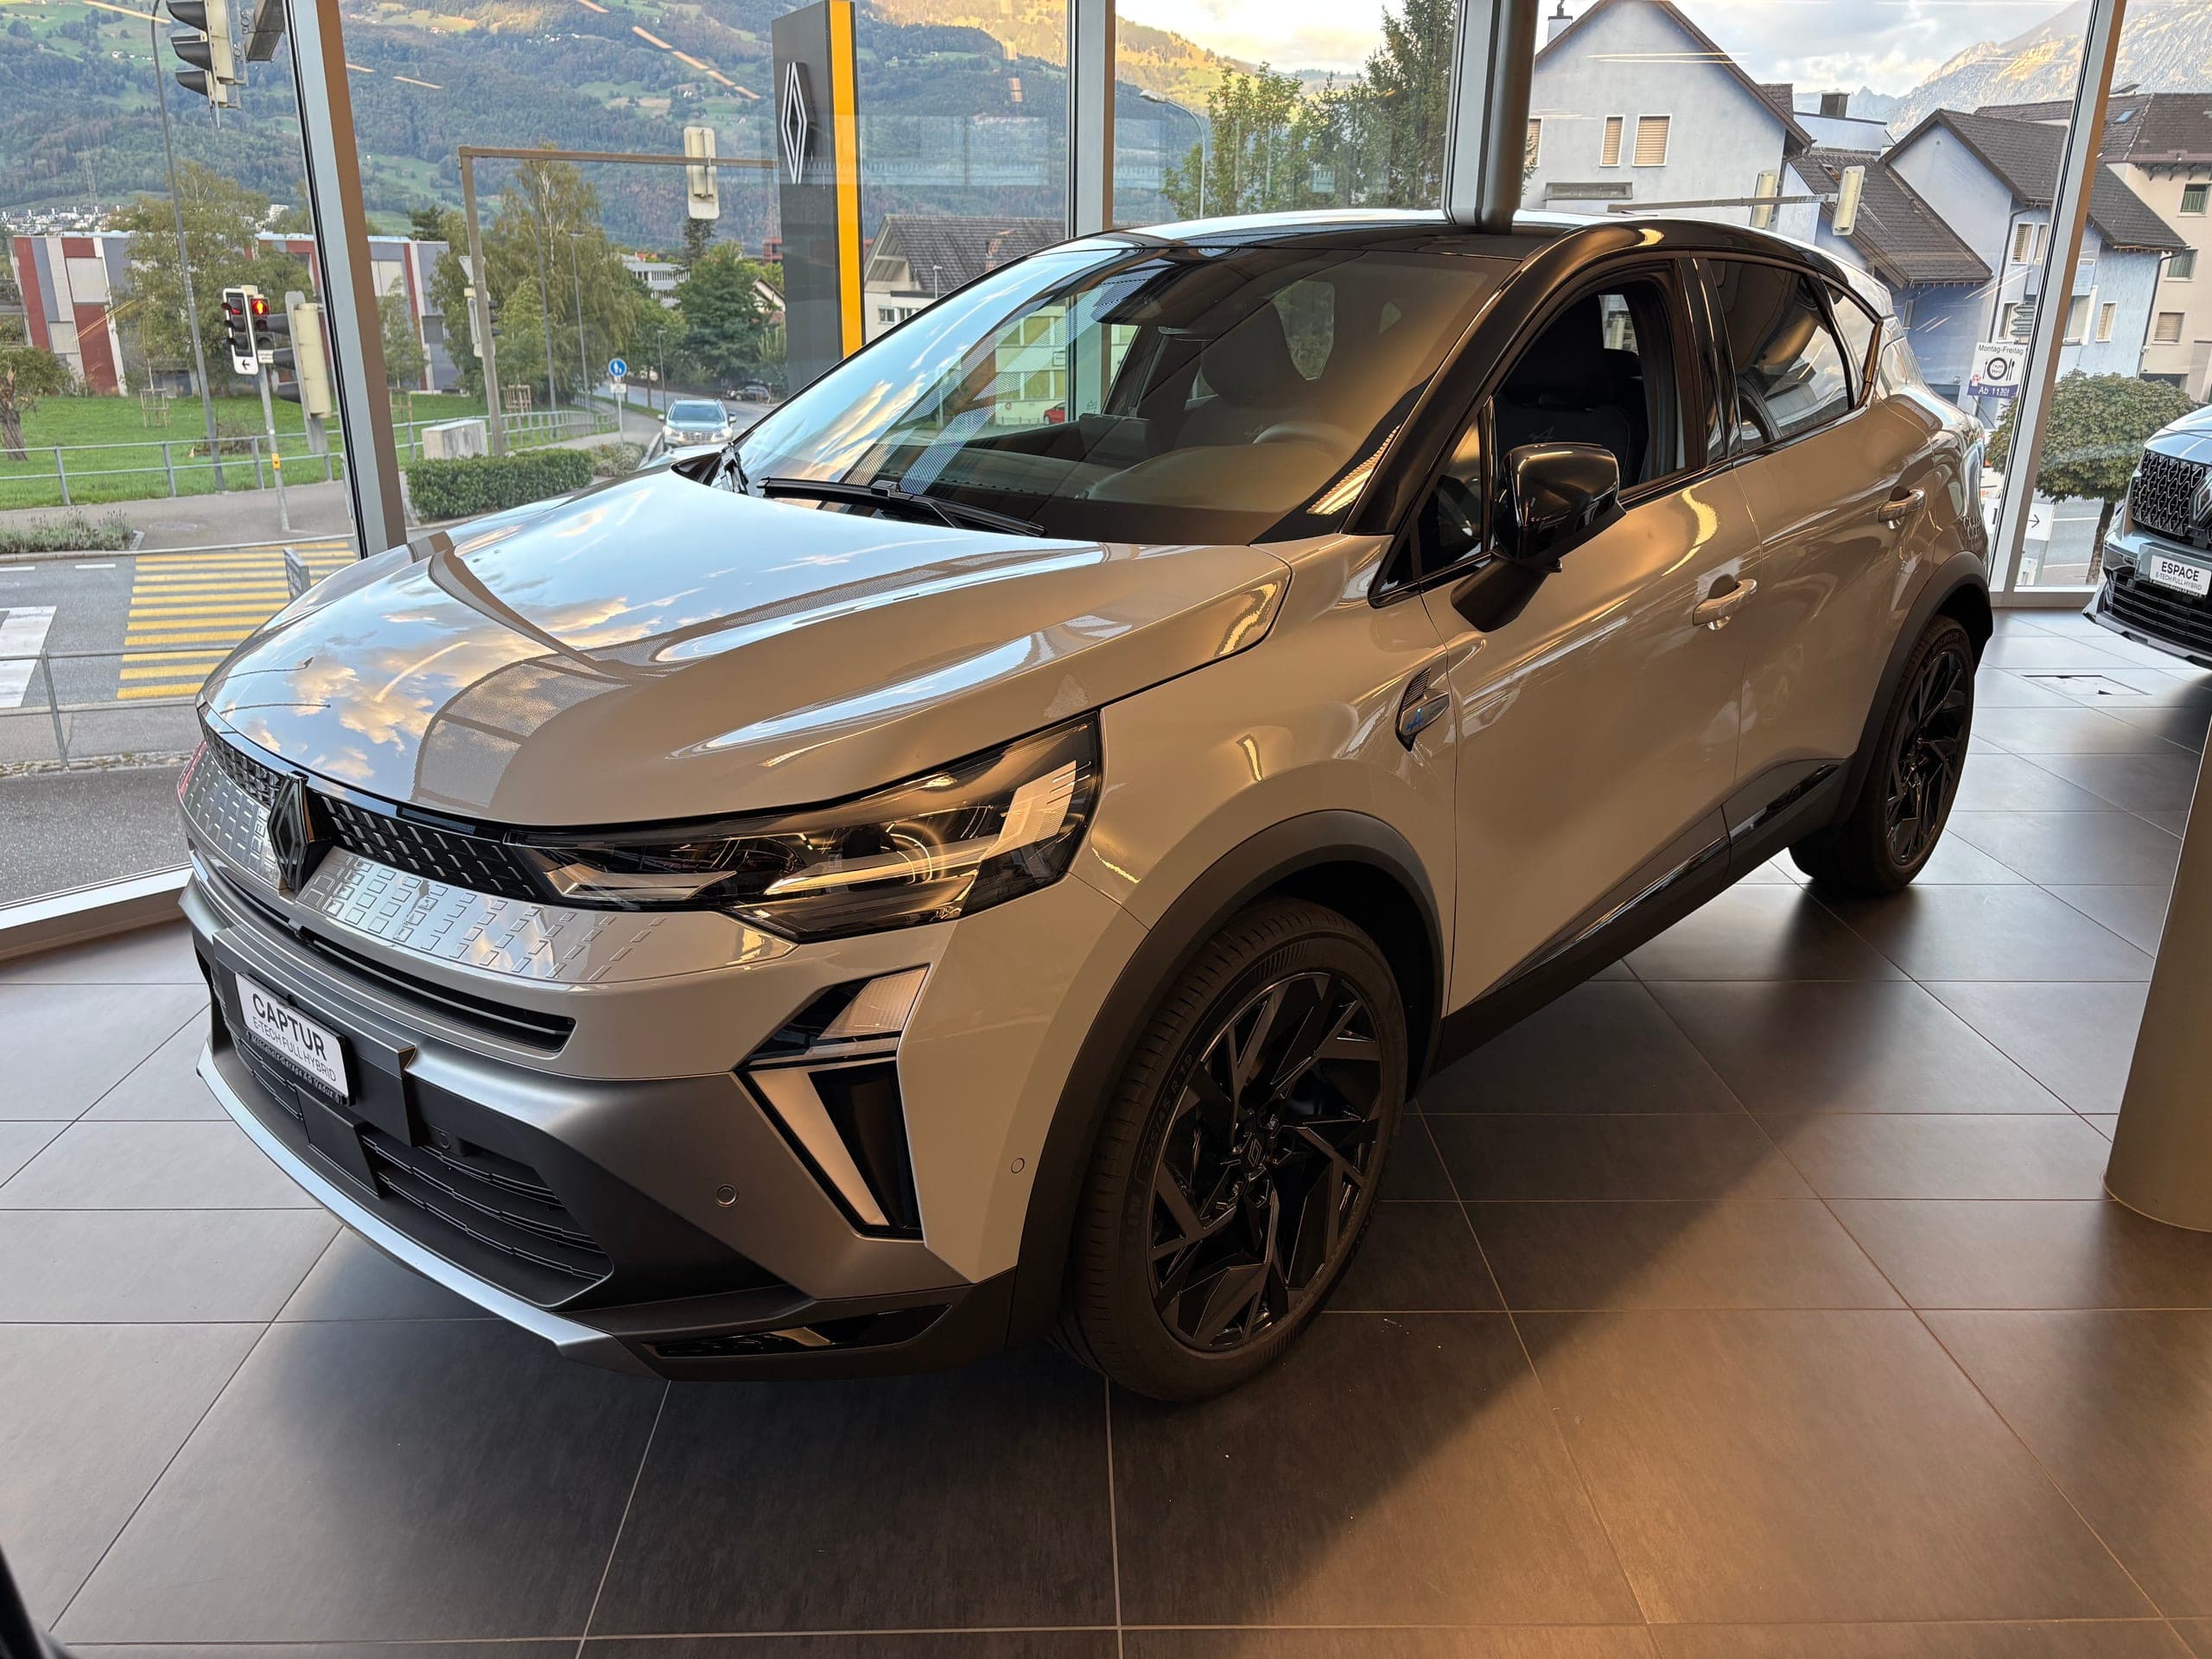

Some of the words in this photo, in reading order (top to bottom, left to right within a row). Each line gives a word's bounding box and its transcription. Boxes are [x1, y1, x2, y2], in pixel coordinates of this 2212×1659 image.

[1978, 385, 1989, 395] Ab
[2161, 561, 2200, 582] ESPACE
[2172, 575, 2184, 586] FULL
[2183, 579, 2202, 591] HYBRID
[252, 993, 327, 1061] CAPTUR
[252, 1016, 281, 1044] E-TECH
[282, 1036, 304, 1059] FULL
[303, 1050, 337, 1083] HYBRID
